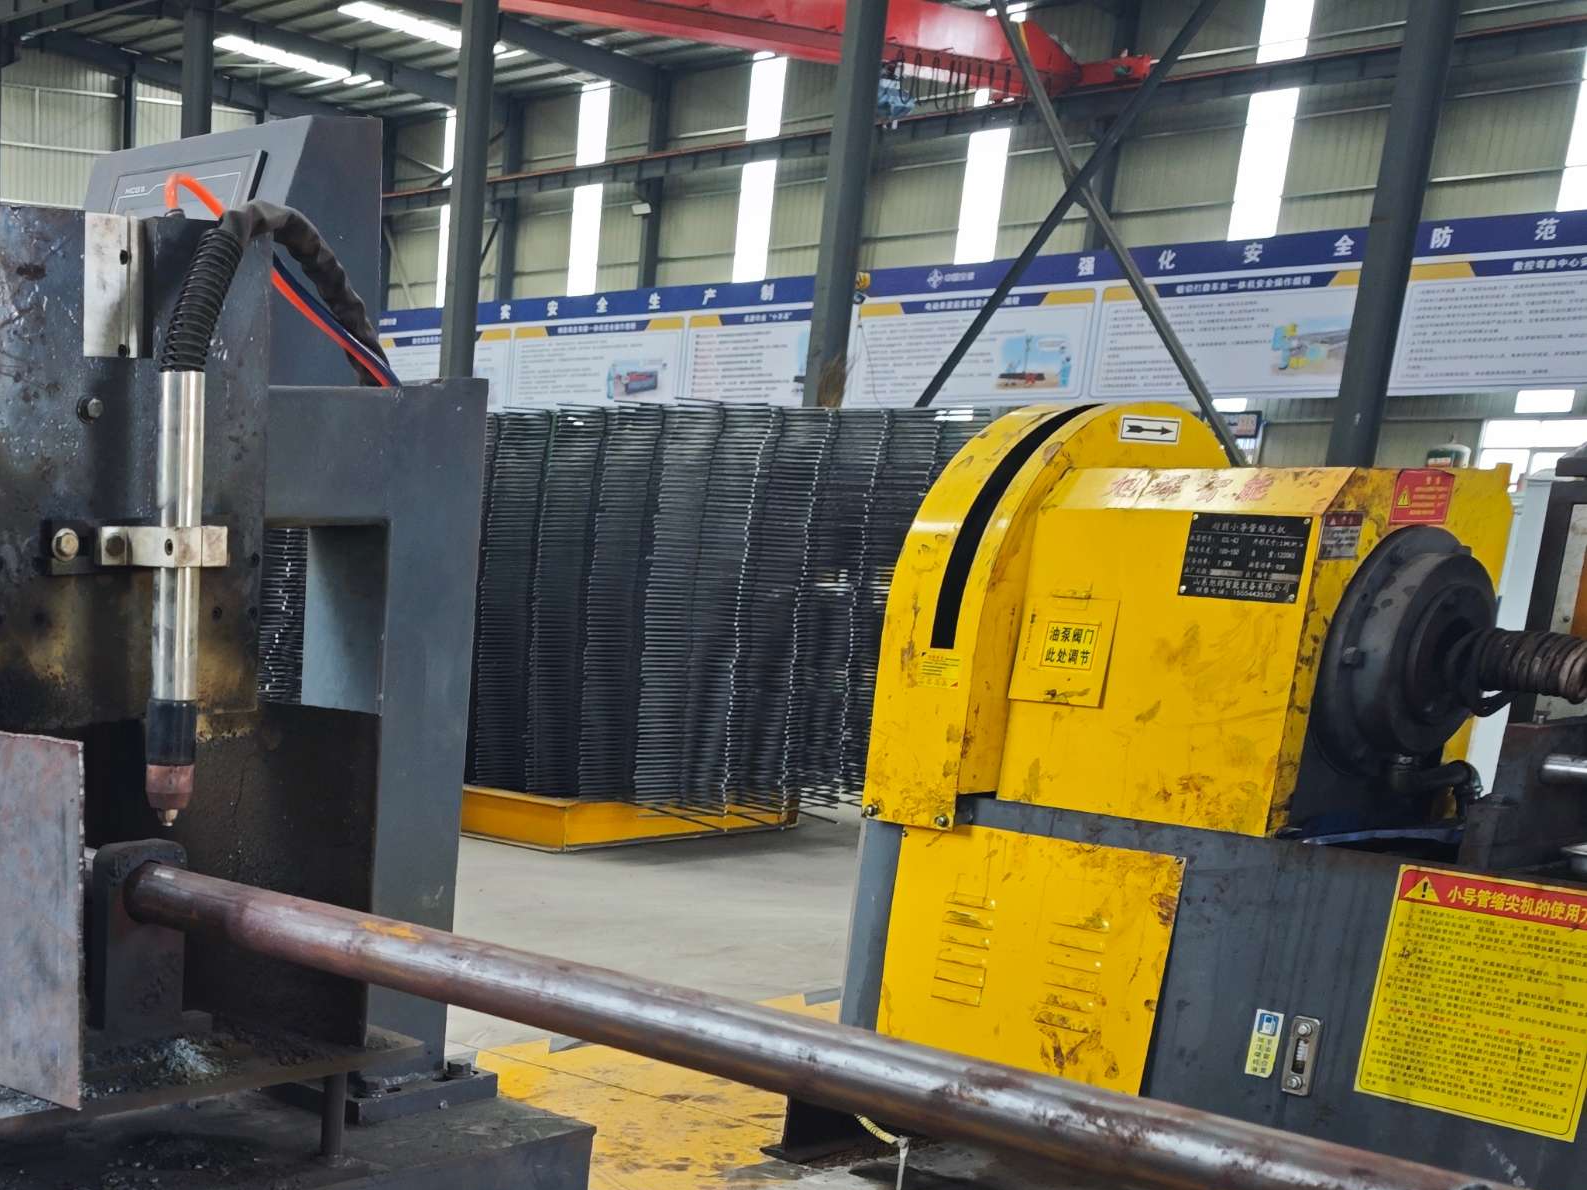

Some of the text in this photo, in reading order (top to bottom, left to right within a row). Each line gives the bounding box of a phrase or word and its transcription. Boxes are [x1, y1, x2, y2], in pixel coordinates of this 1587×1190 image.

[1049, 626, 1095, 645] 油泵阀门
[1045, 647, 1091, 666] 此处调节
